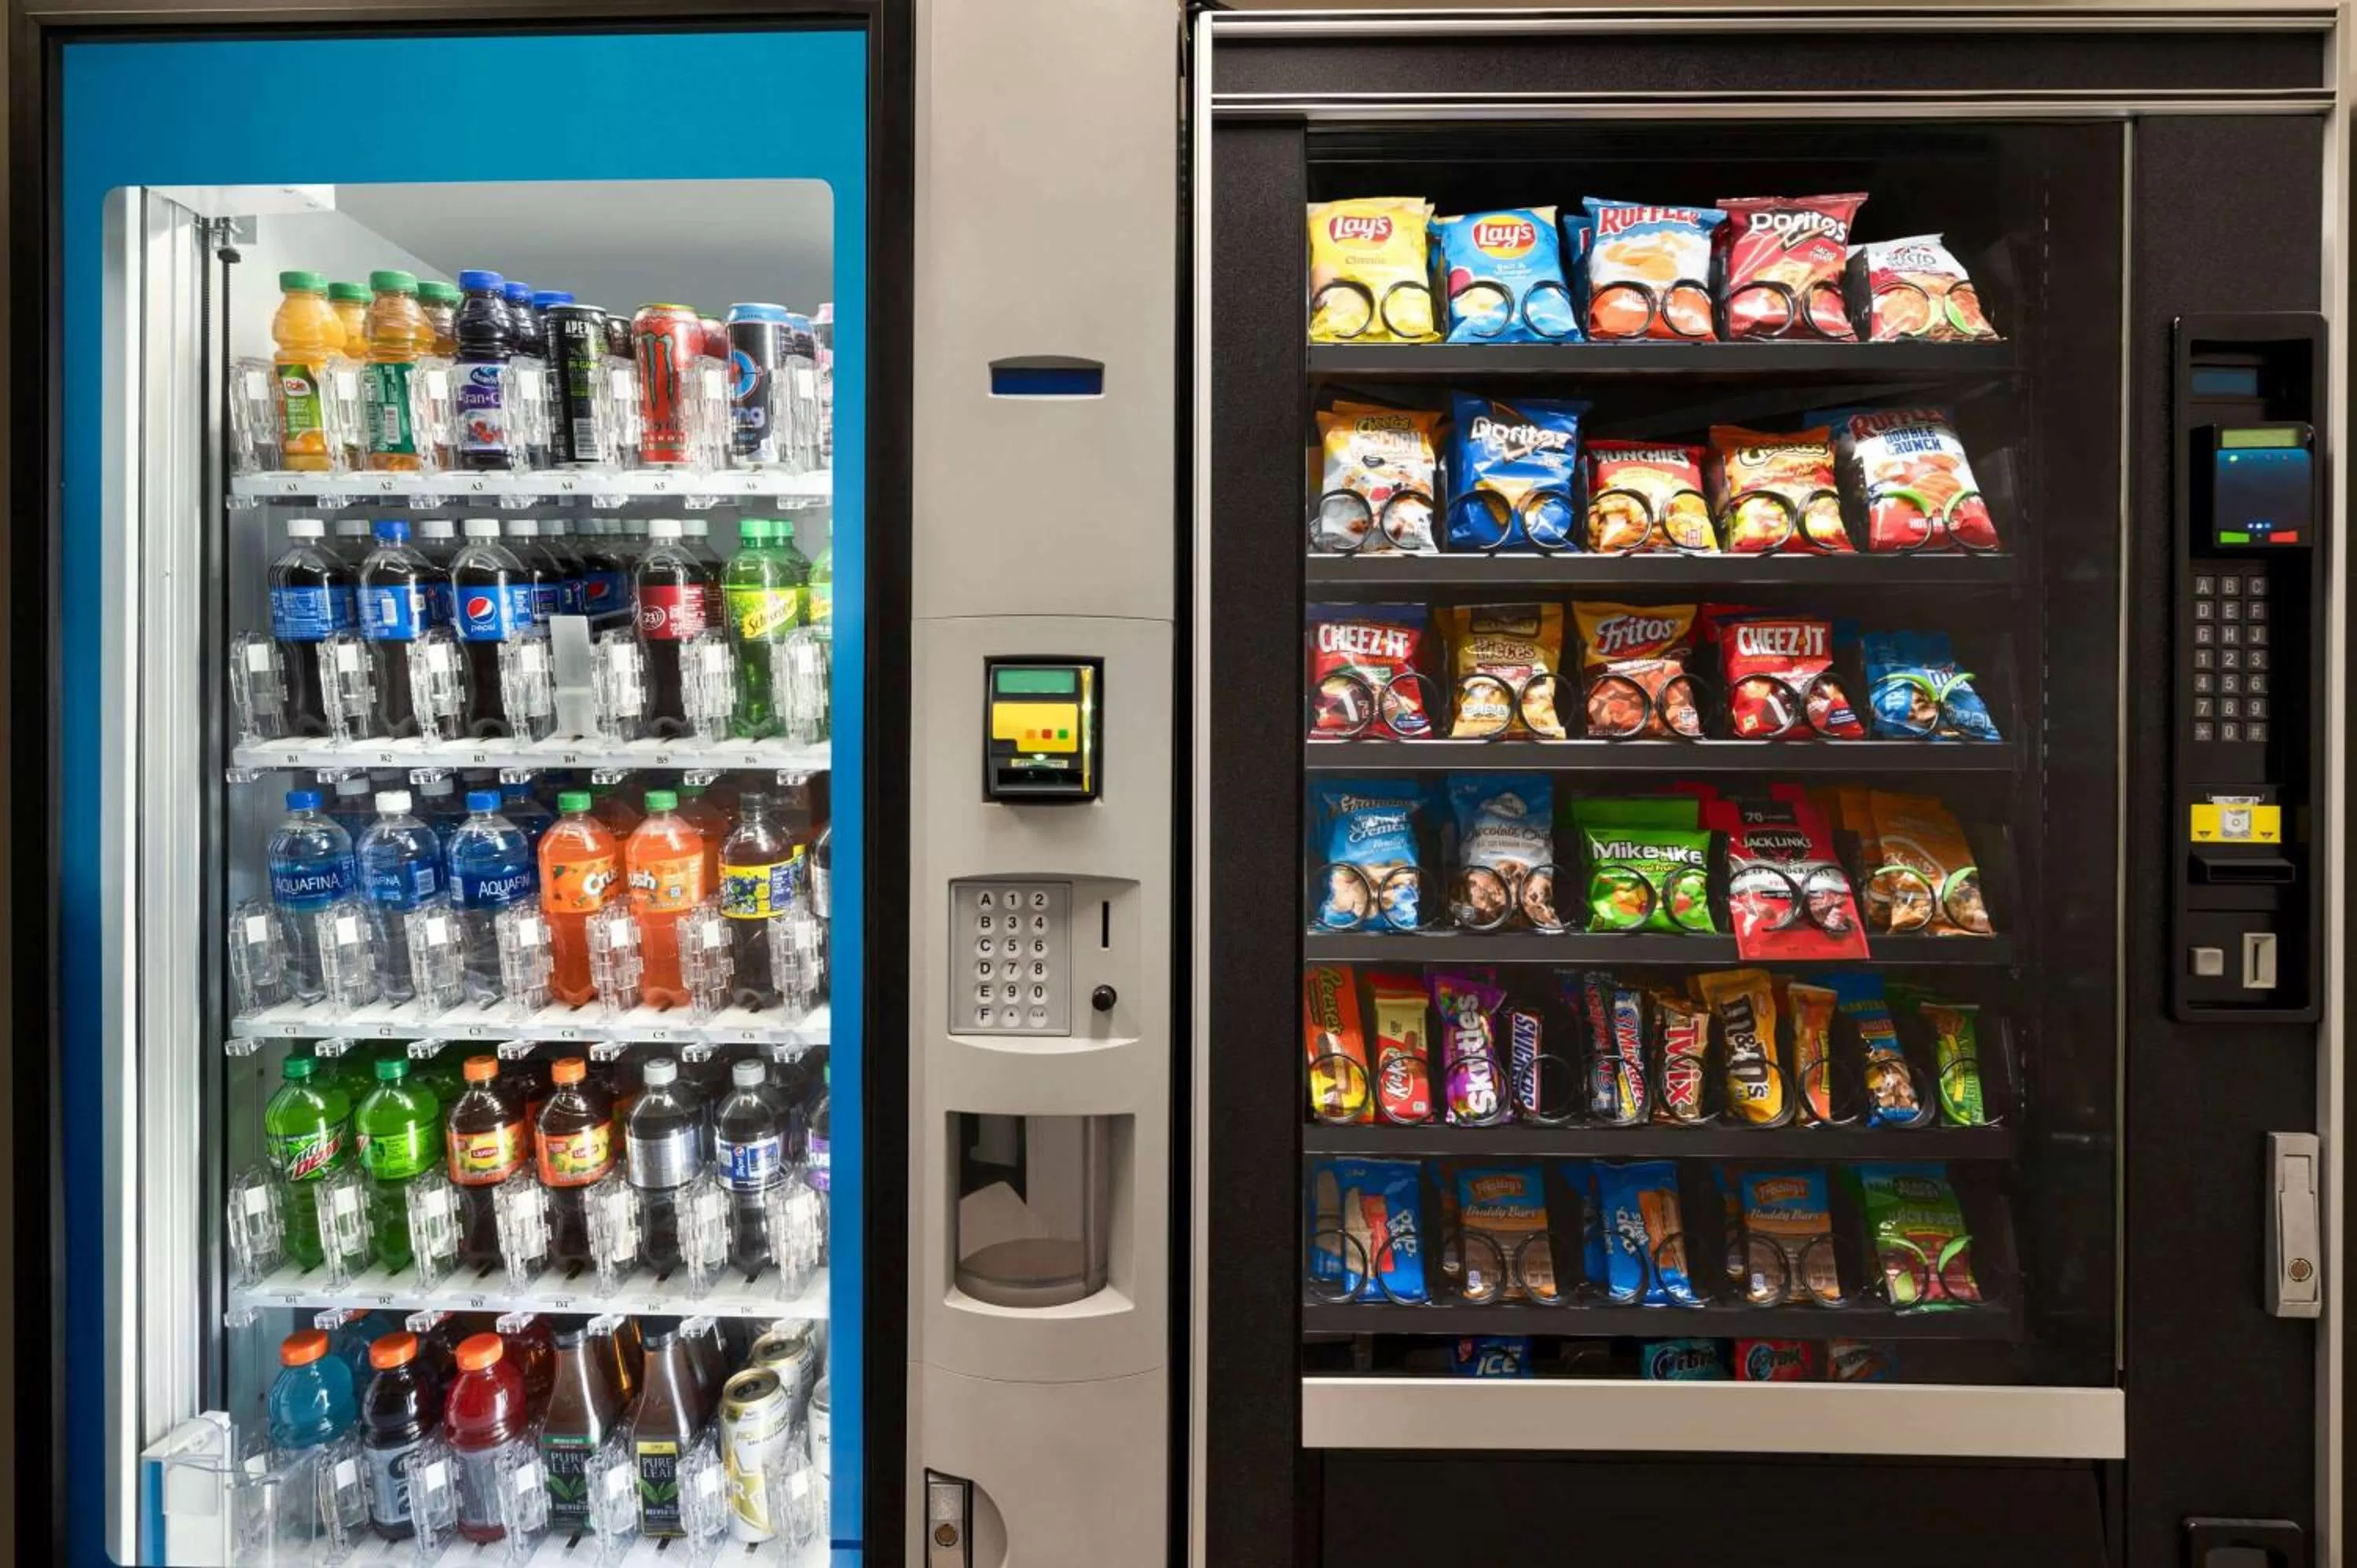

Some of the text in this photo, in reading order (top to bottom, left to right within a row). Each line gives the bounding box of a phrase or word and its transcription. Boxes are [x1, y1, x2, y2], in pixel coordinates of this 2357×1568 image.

[1334, 217, 1388, 242] Lay's
[1751, 211, 1848, 243] Doritos
[1480, 222, 1532, 248] Lay's
[2199, 580, 2261, 593] A B C
[2199, 604, 2260, 618] D E F
[1596, 614, 1676, 654] Fritos
[2199, 629, 2260, 642] G H J
[2200, 654, 2260, 665] 1 2 3
[2198, 677, 2260, 691] 4 5 6
[2199, 702, 2260, 715] 7 8 9
[2224, 725, 2234, 738] 0
[1745, 812, 1764, 822] 70
[1743, 836, 1772, 848] JACK
[276, 873, 340, 895] AQUAFINA
[479, 872, 532, 897] AQUAFIN
[628, 870, 657, 890] ush
[981, 894, 1044, 906] A 1 2
[982, 917, 1043, 929] B 3 4
[981, 940, 1043, 952] C 5 6
[981, 963, 1043, 975] D 7 8
[981, 985, 1043, 998] E 9 0
[981, 1009, 989, 1020] F
[1476, 1355, 1517, 1376] ICE
